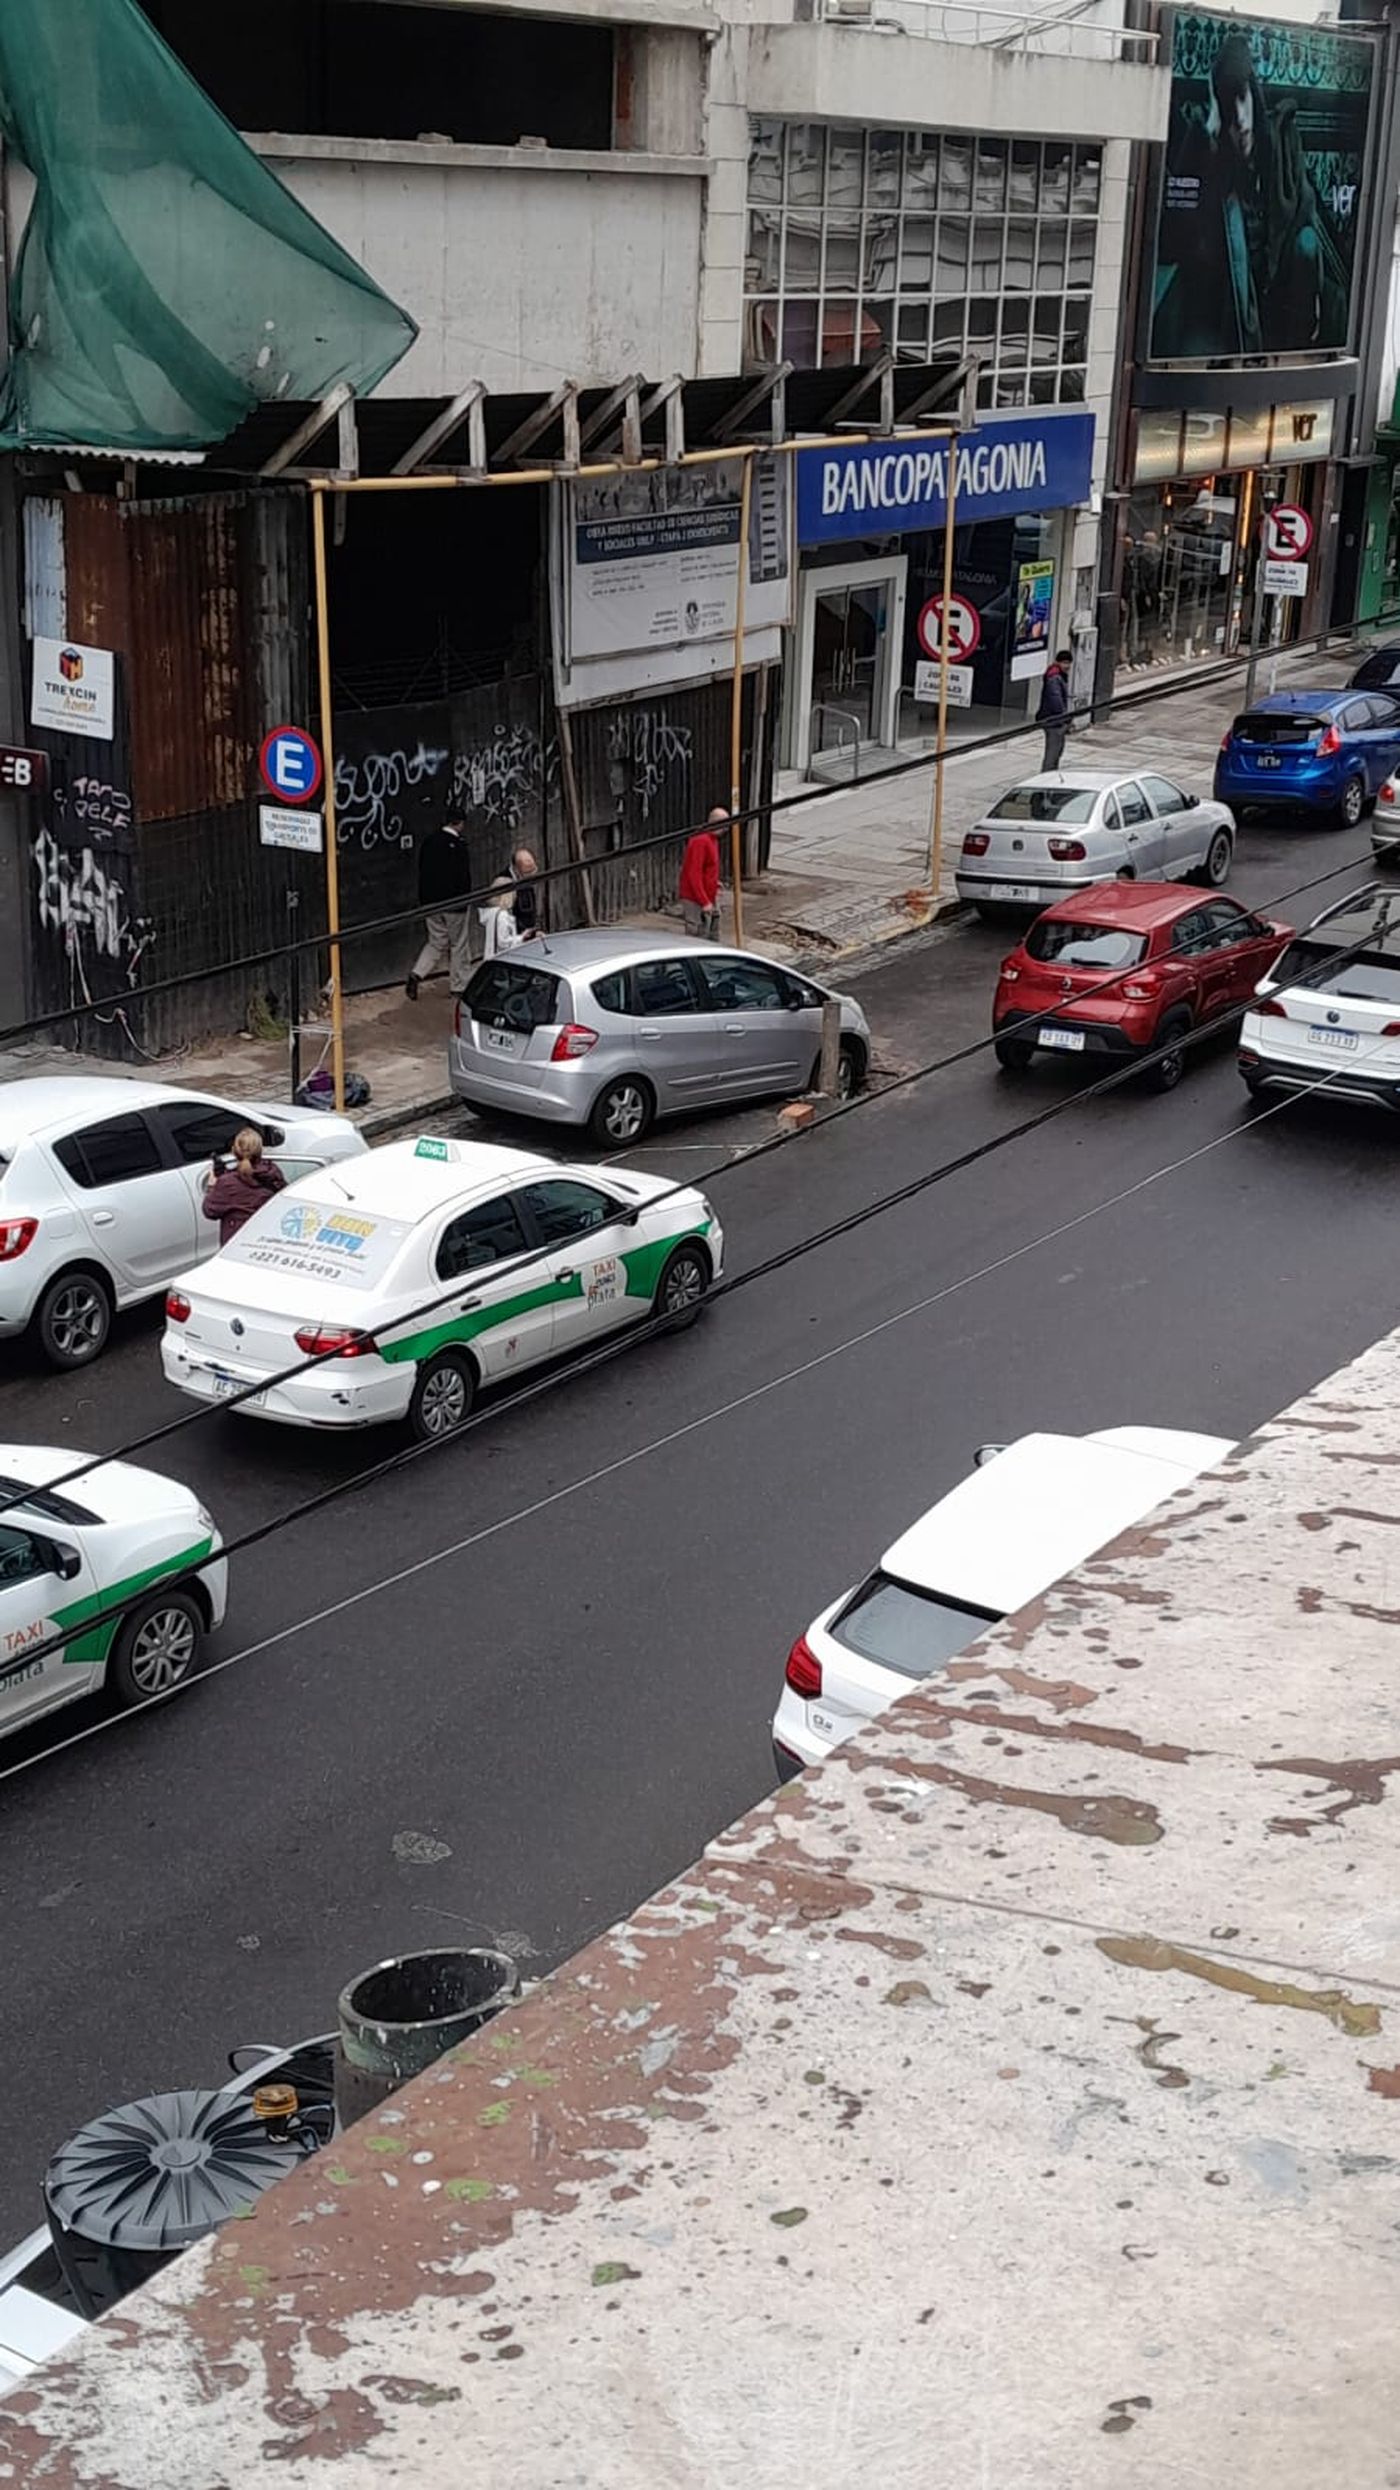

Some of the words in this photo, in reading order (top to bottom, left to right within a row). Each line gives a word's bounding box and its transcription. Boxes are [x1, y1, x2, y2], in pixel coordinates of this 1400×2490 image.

[276, 740, 305, 789] E
[593, 1257, 616, 1278] TAXI
[3, 1619, 44, 1651] TAXI
